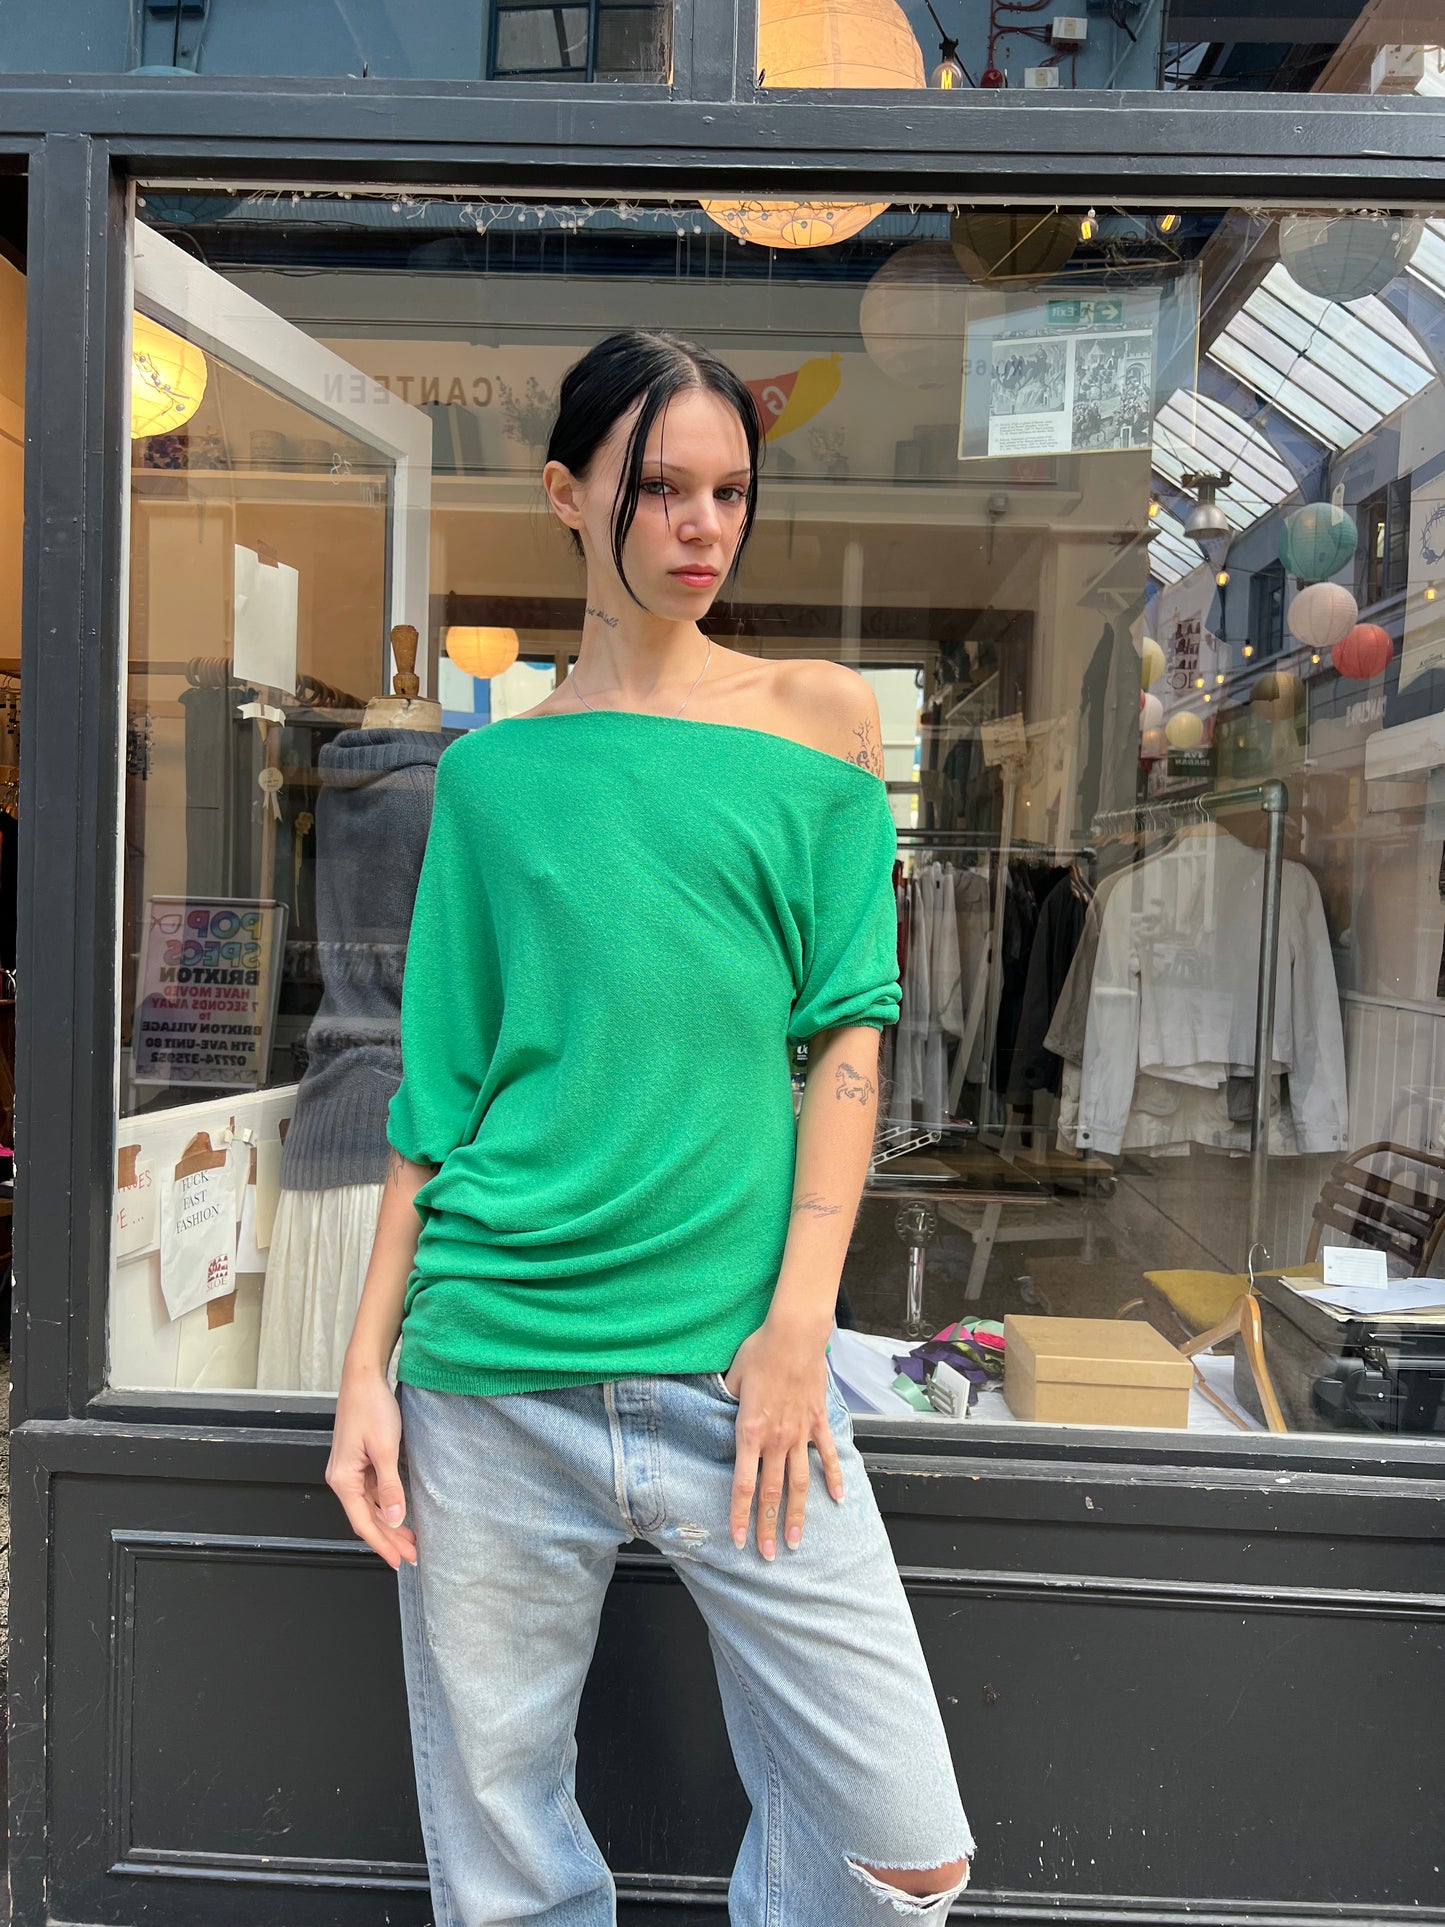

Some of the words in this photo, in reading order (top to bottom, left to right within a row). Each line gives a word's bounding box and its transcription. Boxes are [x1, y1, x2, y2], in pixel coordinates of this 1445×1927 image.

[182, 1170, 209, 1192] FUCK
[183, 1189, 208, 1210] FAST
[176, 1203, 220, 1234] FASHION
